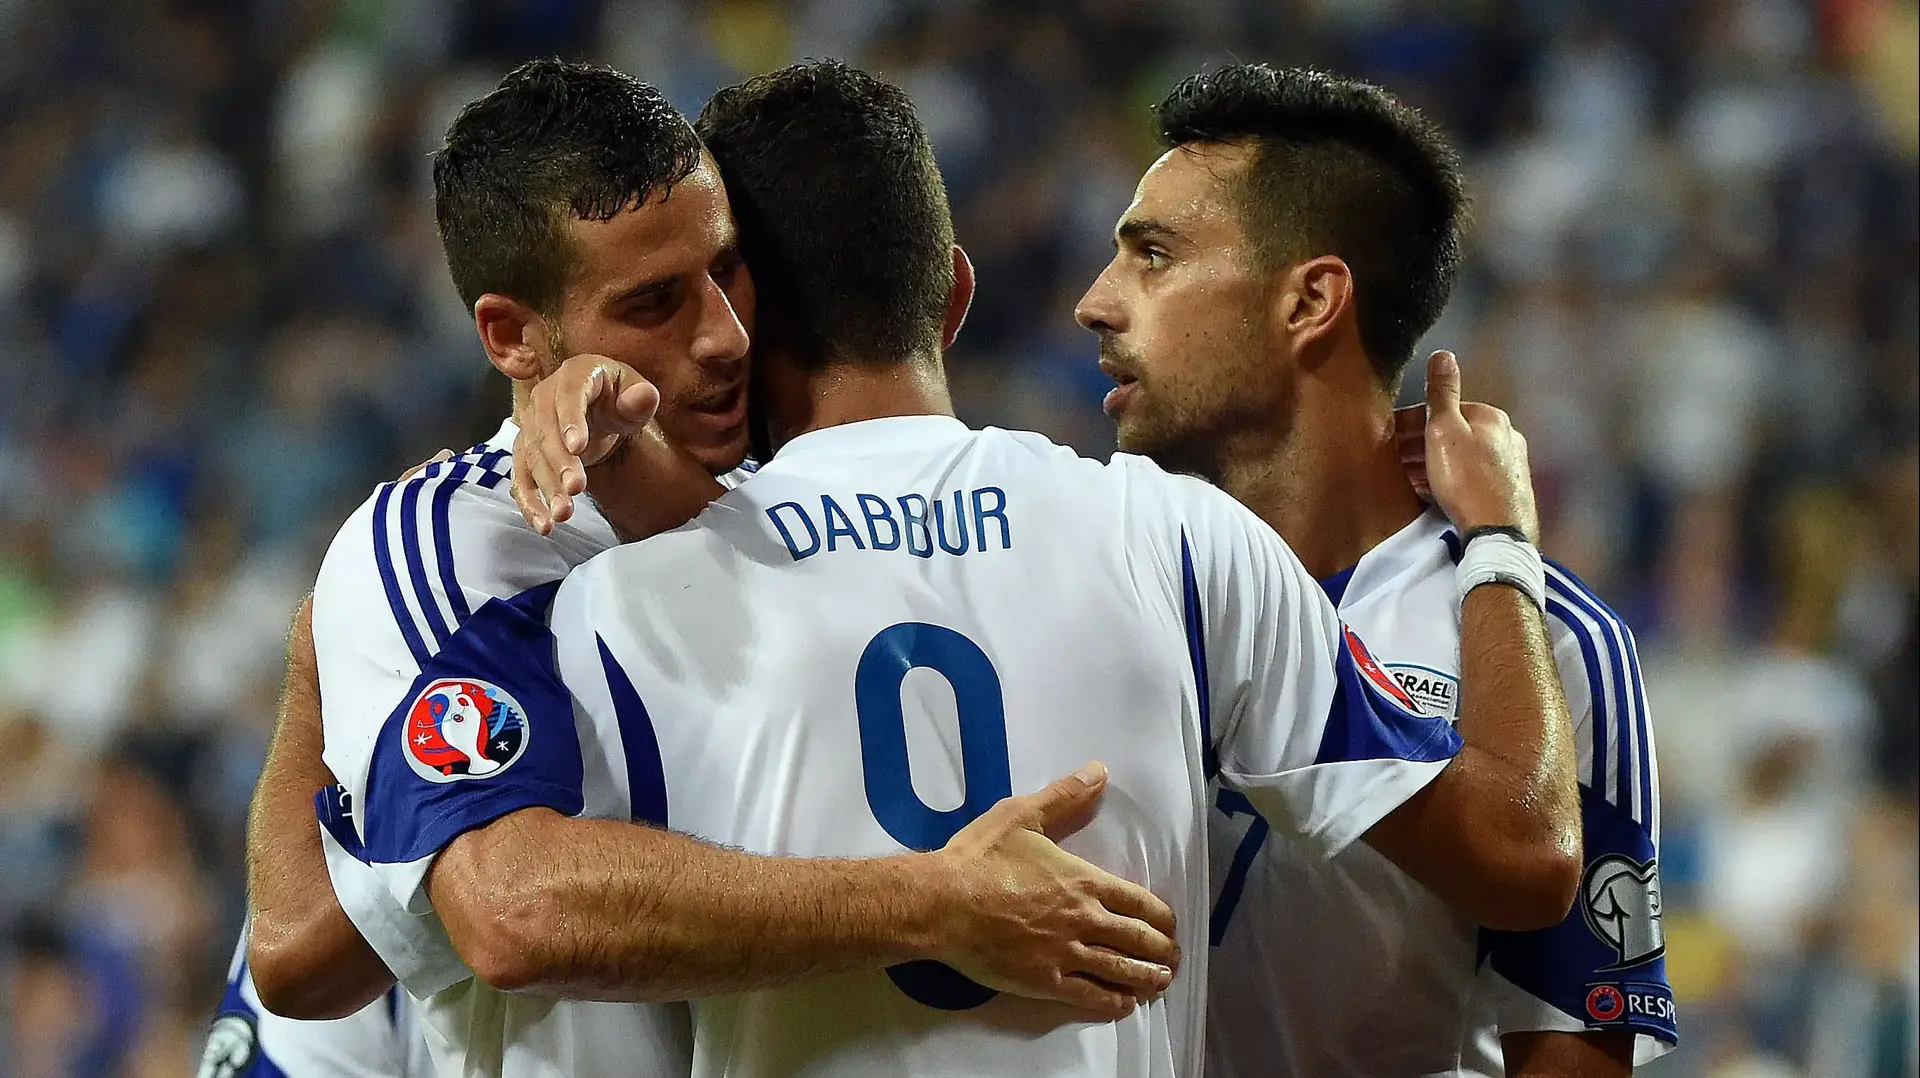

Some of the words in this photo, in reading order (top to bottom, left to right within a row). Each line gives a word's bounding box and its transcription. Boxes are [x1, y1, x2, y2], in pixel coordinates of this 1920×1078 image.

[765, 486, 1012, 562] DABBUR
[1393, 672, 1452, 699] SRAEL
[1208, 787, 1270, 947] 7
